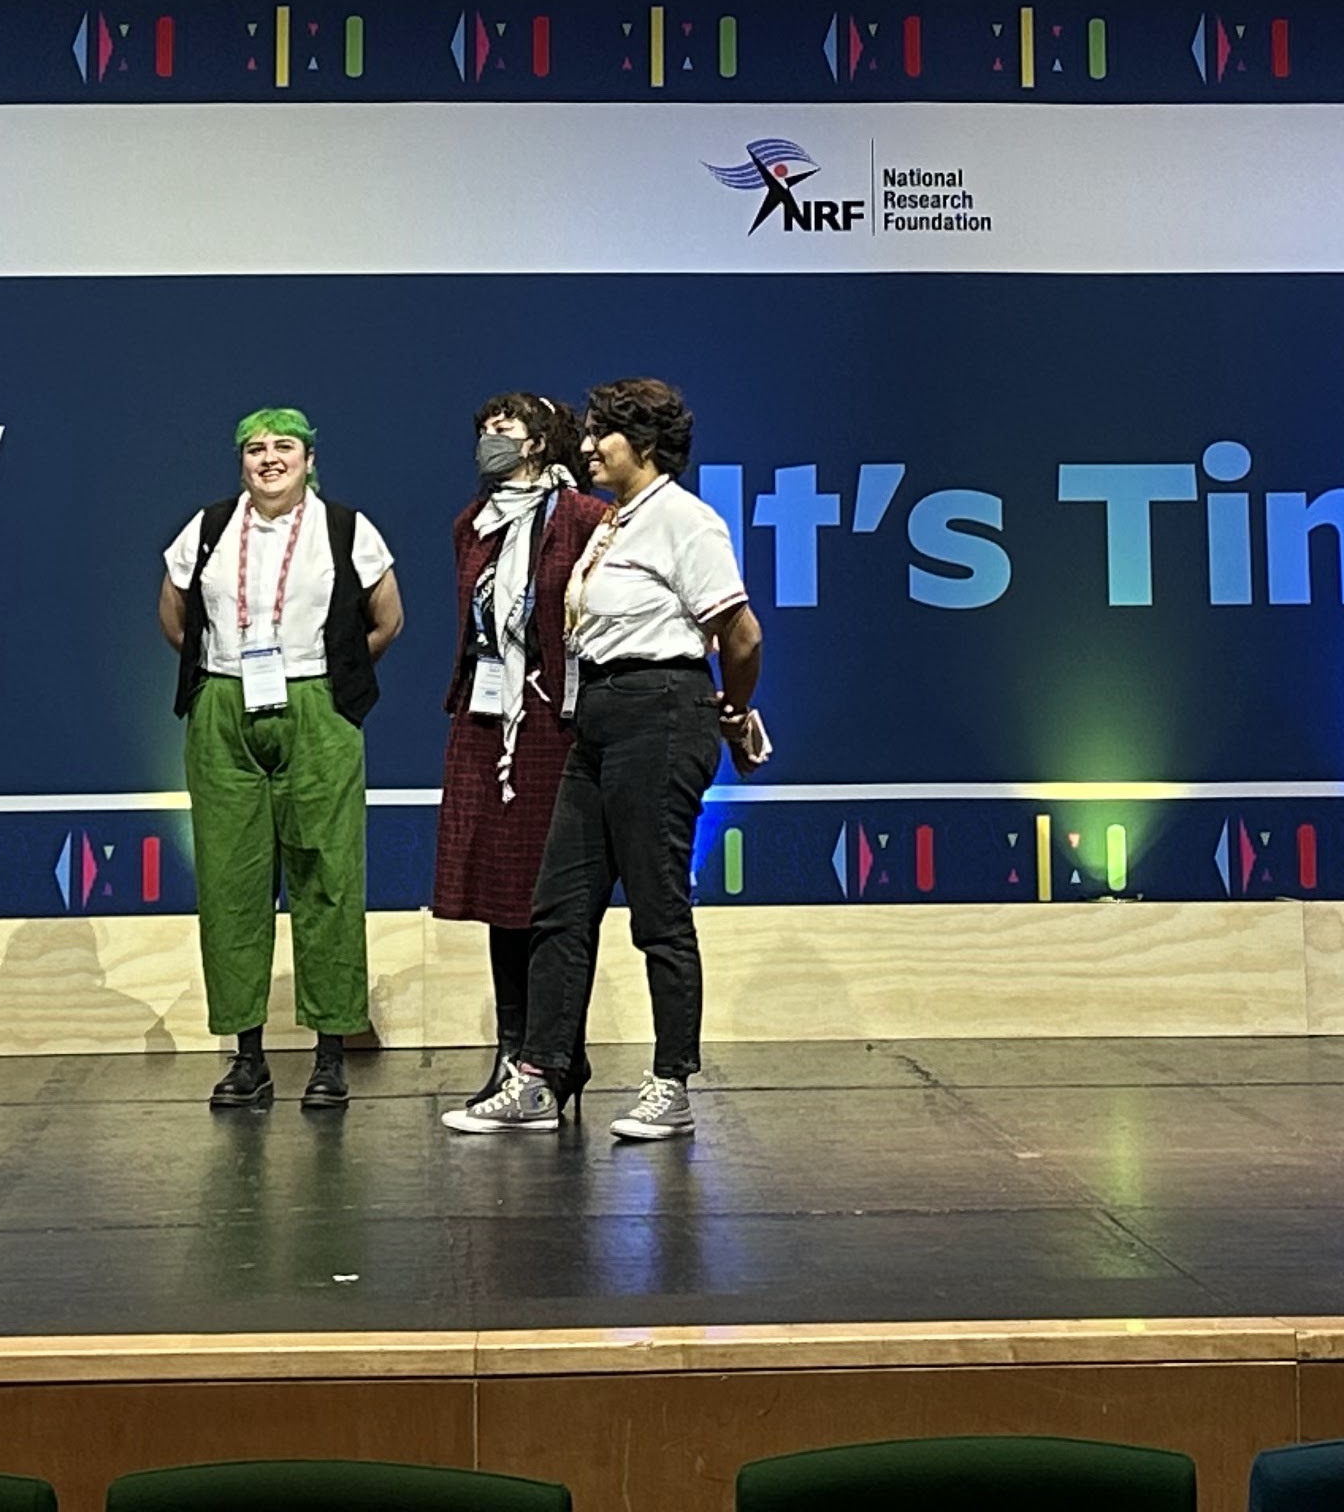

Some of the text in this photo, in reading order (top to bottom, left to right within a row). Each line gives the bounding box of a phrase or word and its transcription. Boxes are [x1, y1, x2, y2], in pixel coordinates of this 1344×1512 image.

[882, 167, 964, 188] National
[883, 190, 974, 209] Research
[783, 200, 865, 232] NRF
[883, 211, 993, 232] Foundation
